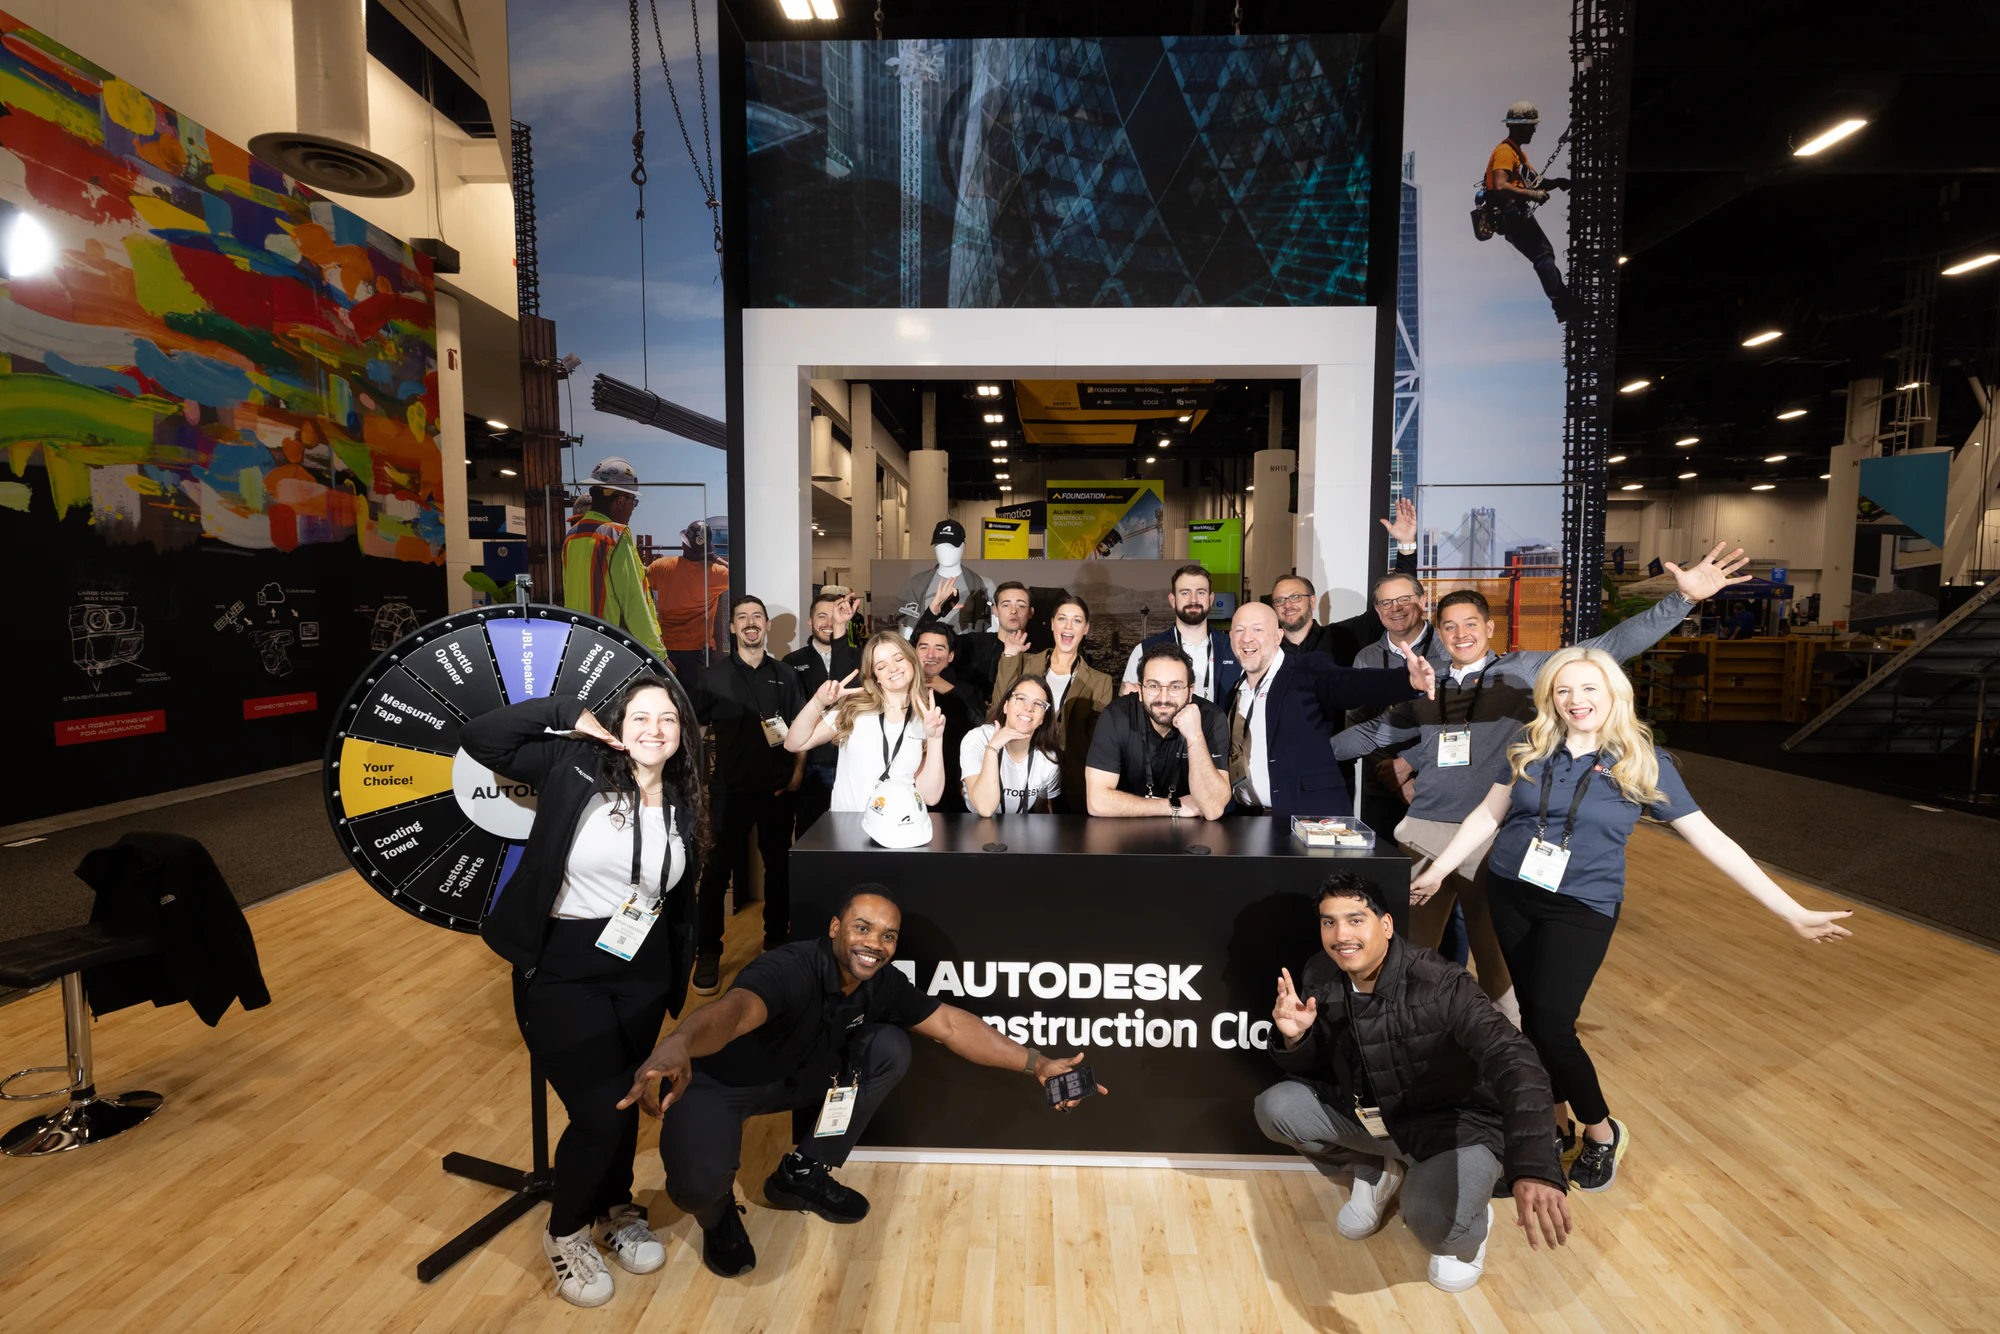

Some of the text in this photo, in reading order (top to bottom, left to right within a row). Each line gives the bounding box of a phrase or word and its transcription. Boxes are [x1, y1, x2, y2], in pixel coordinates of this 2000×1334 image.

[1061, 492, 1107, 500] FOUNDATION
[435, 648, 464, 686] Opener
[448, 641, 473, 674] Bottle
[521, 629, 535, 696] JBL Speaker
[578, 643, 604, 674] Pencil
[88, 721, 115, 729] REBAR
[117, 718, 138, 726] TYING
[373, 704, 403, 726] Tape
[380, 692, 447, 731] Measuring
[98, 723, 146, 735] AUTOMATION
[363, 763, 395, 773] Your
[363, 776, 414, 787] Choice!
[374, 820, 423, 849] Cooling
[380, 837, 419, 860] Towel
[438, 854, 470, 894] Custom
[451, 856, 485, 898] T-Shirts
[926, 961, 1203, 1001] AUTODESK
